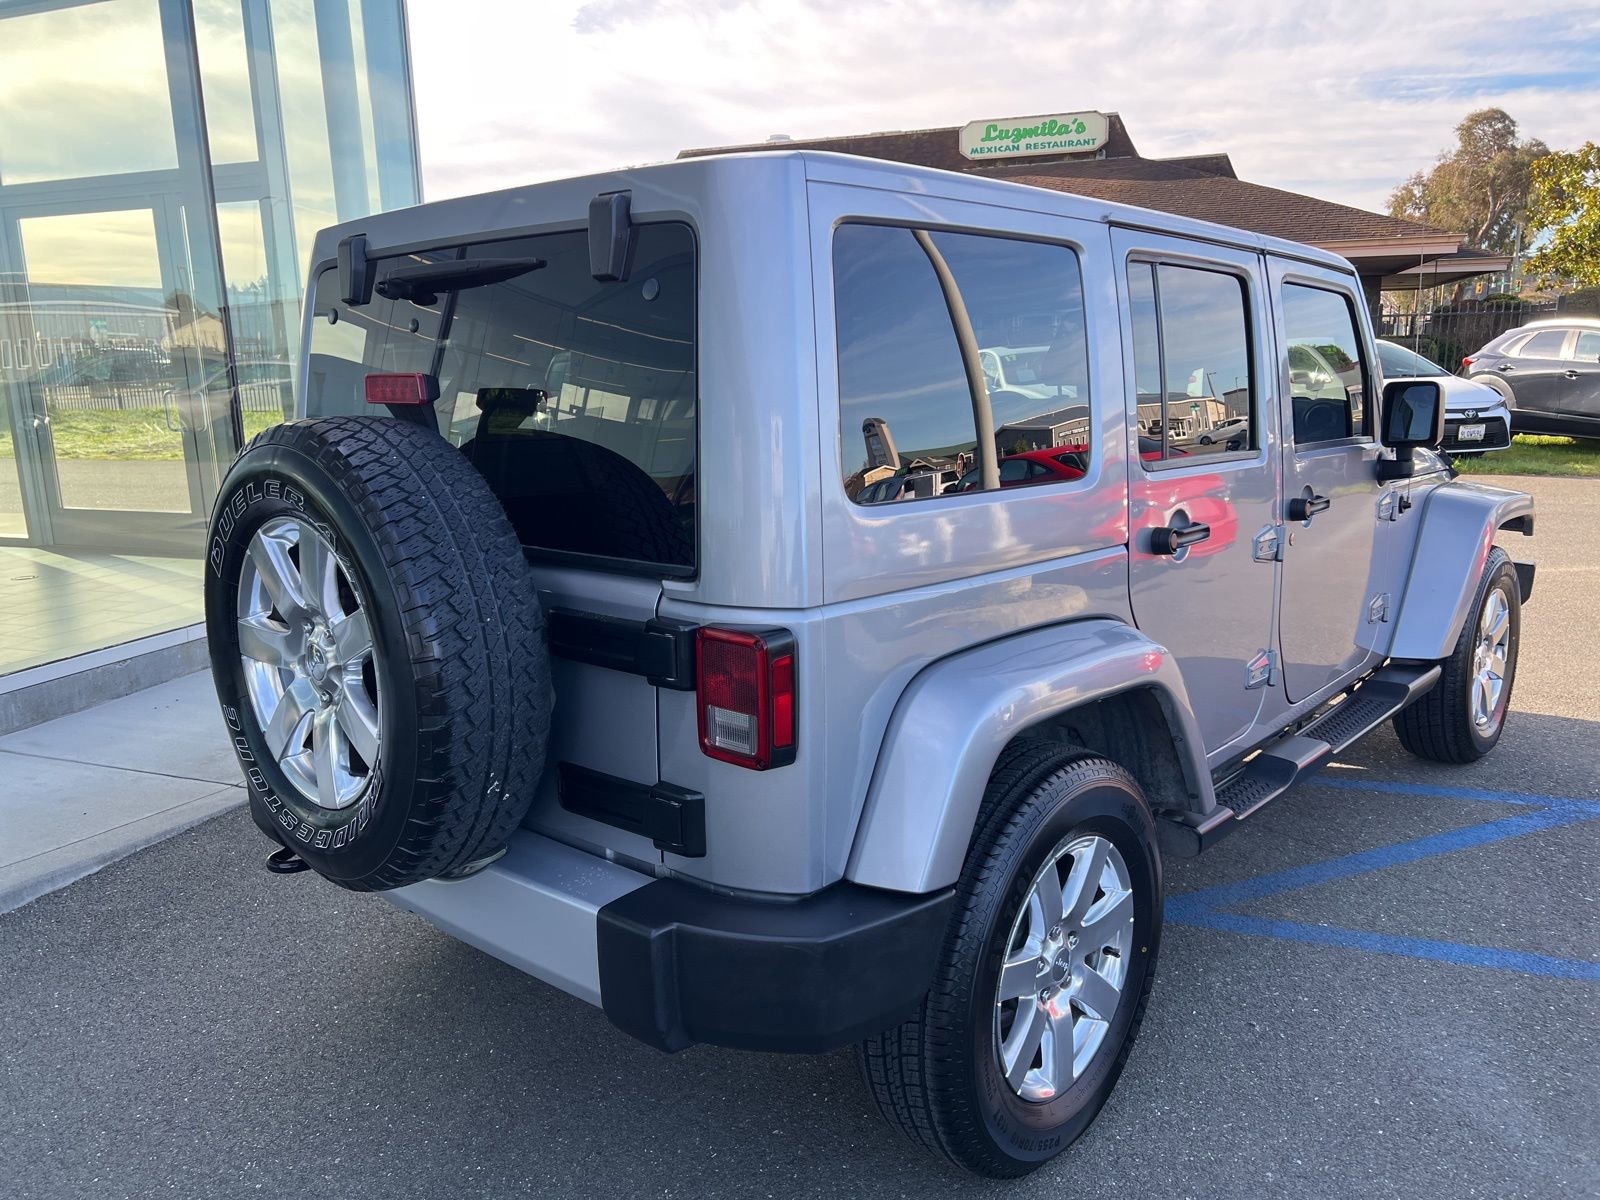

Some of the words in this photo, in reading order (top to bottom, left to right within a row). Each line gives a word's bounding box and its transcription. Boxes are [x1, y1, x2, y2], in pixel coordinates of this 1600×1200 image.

[981, 119, 1086, 143] Luzmila's
[970, 144, 1020, 155] MEXICAN
[1026, 138, 1097, 151] RESTAURANT
[209, 480, 306, 578] DUELER
[223, 704, 383, 849] BRIDGESTONE
[1055, 958, 1068, 972] Jeep
